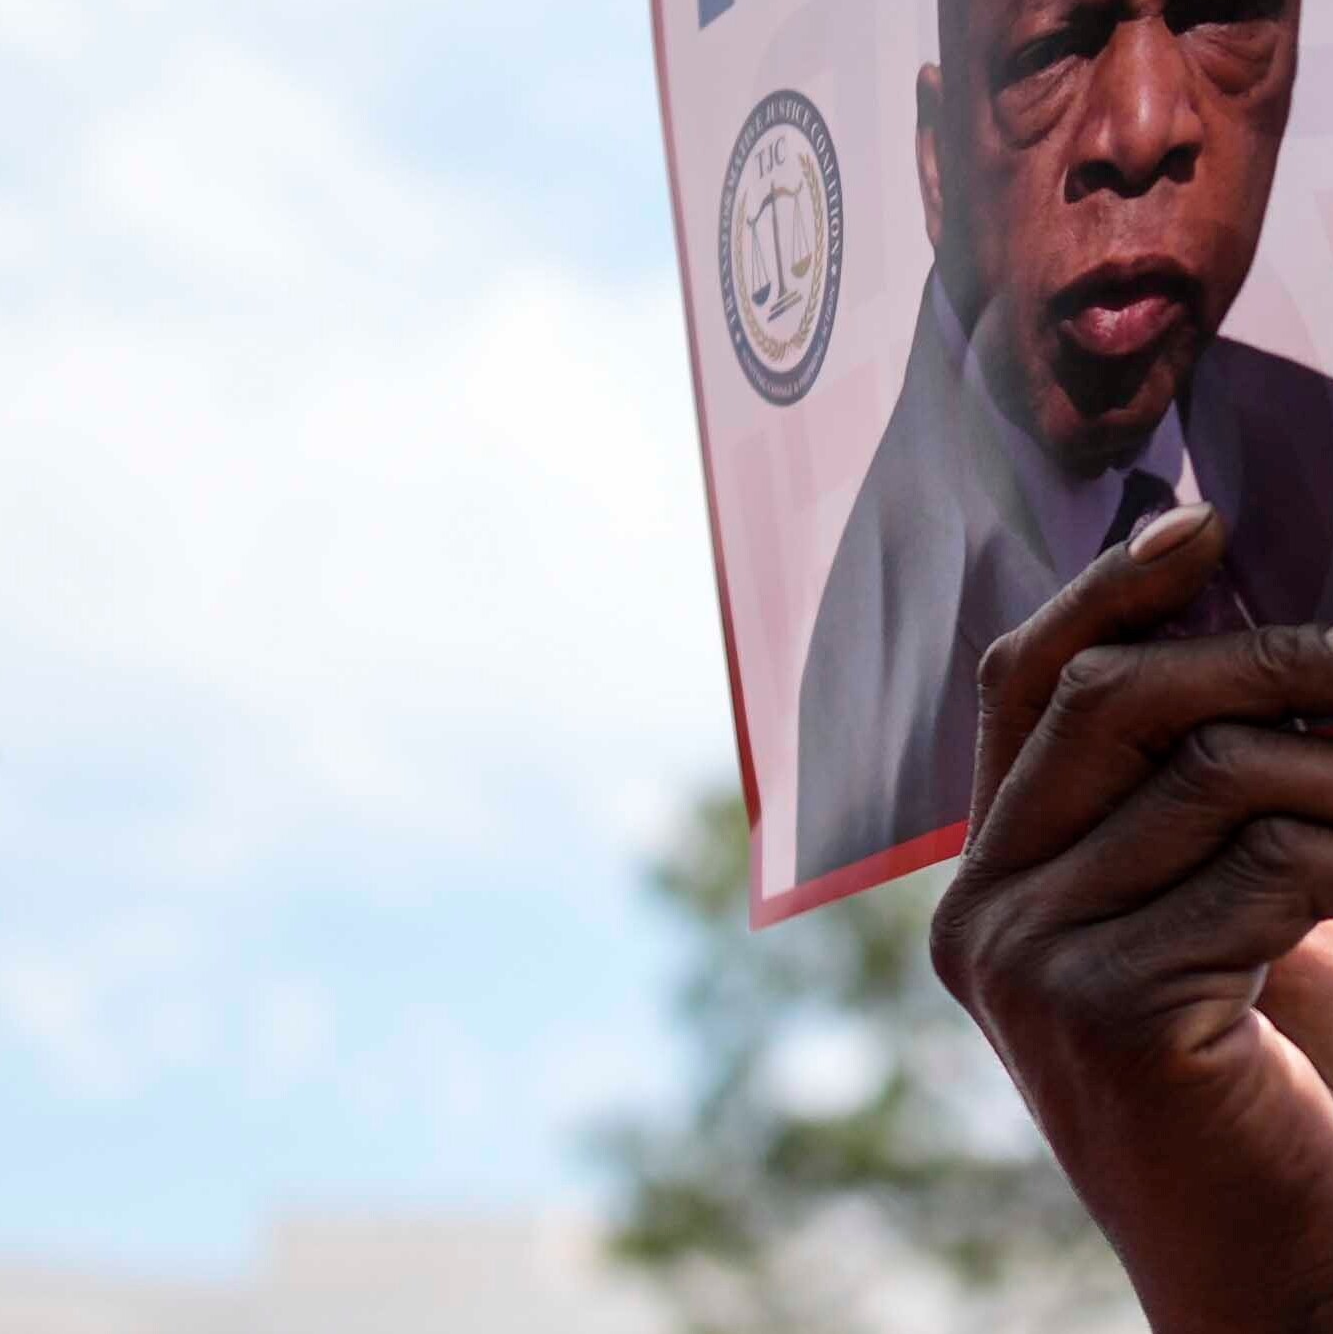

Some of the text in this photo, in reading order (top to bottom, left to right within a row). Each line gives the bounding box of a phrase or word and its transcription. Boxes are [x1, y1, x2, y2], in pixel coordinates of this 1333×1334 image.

[754, 135, 787, 180] TJC
[765, 98, 812, 128] JUSTICE
[810, 122, 840, 256] COALITION
